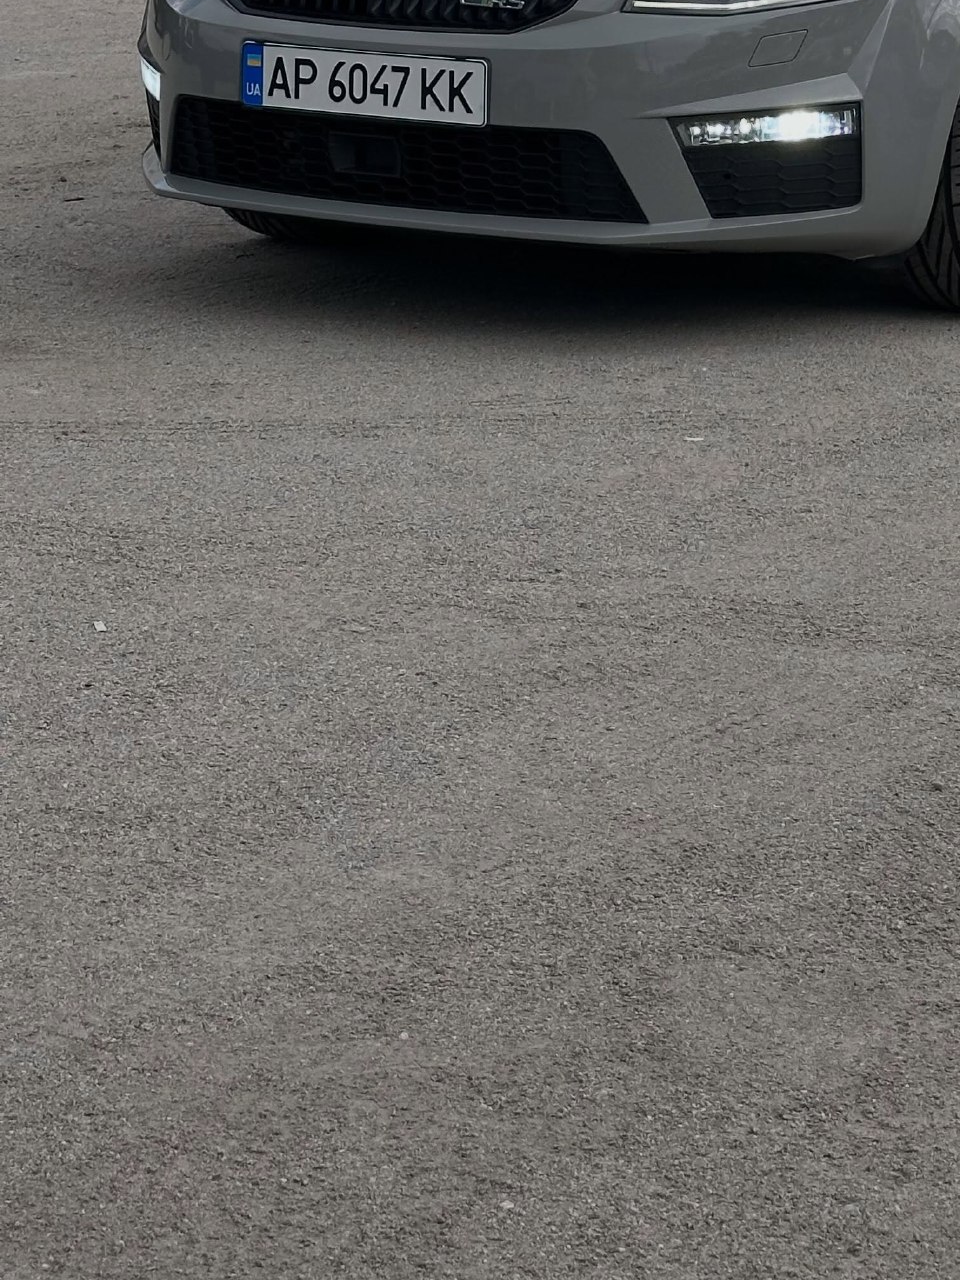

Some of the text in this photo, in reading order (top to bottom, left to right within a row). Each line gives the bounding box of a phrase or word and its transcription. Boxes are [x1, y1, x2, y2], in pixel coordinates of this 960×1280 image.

[246, 82, 261, 97] UA
[267, 56, 474, 114] AP 6047 KK
